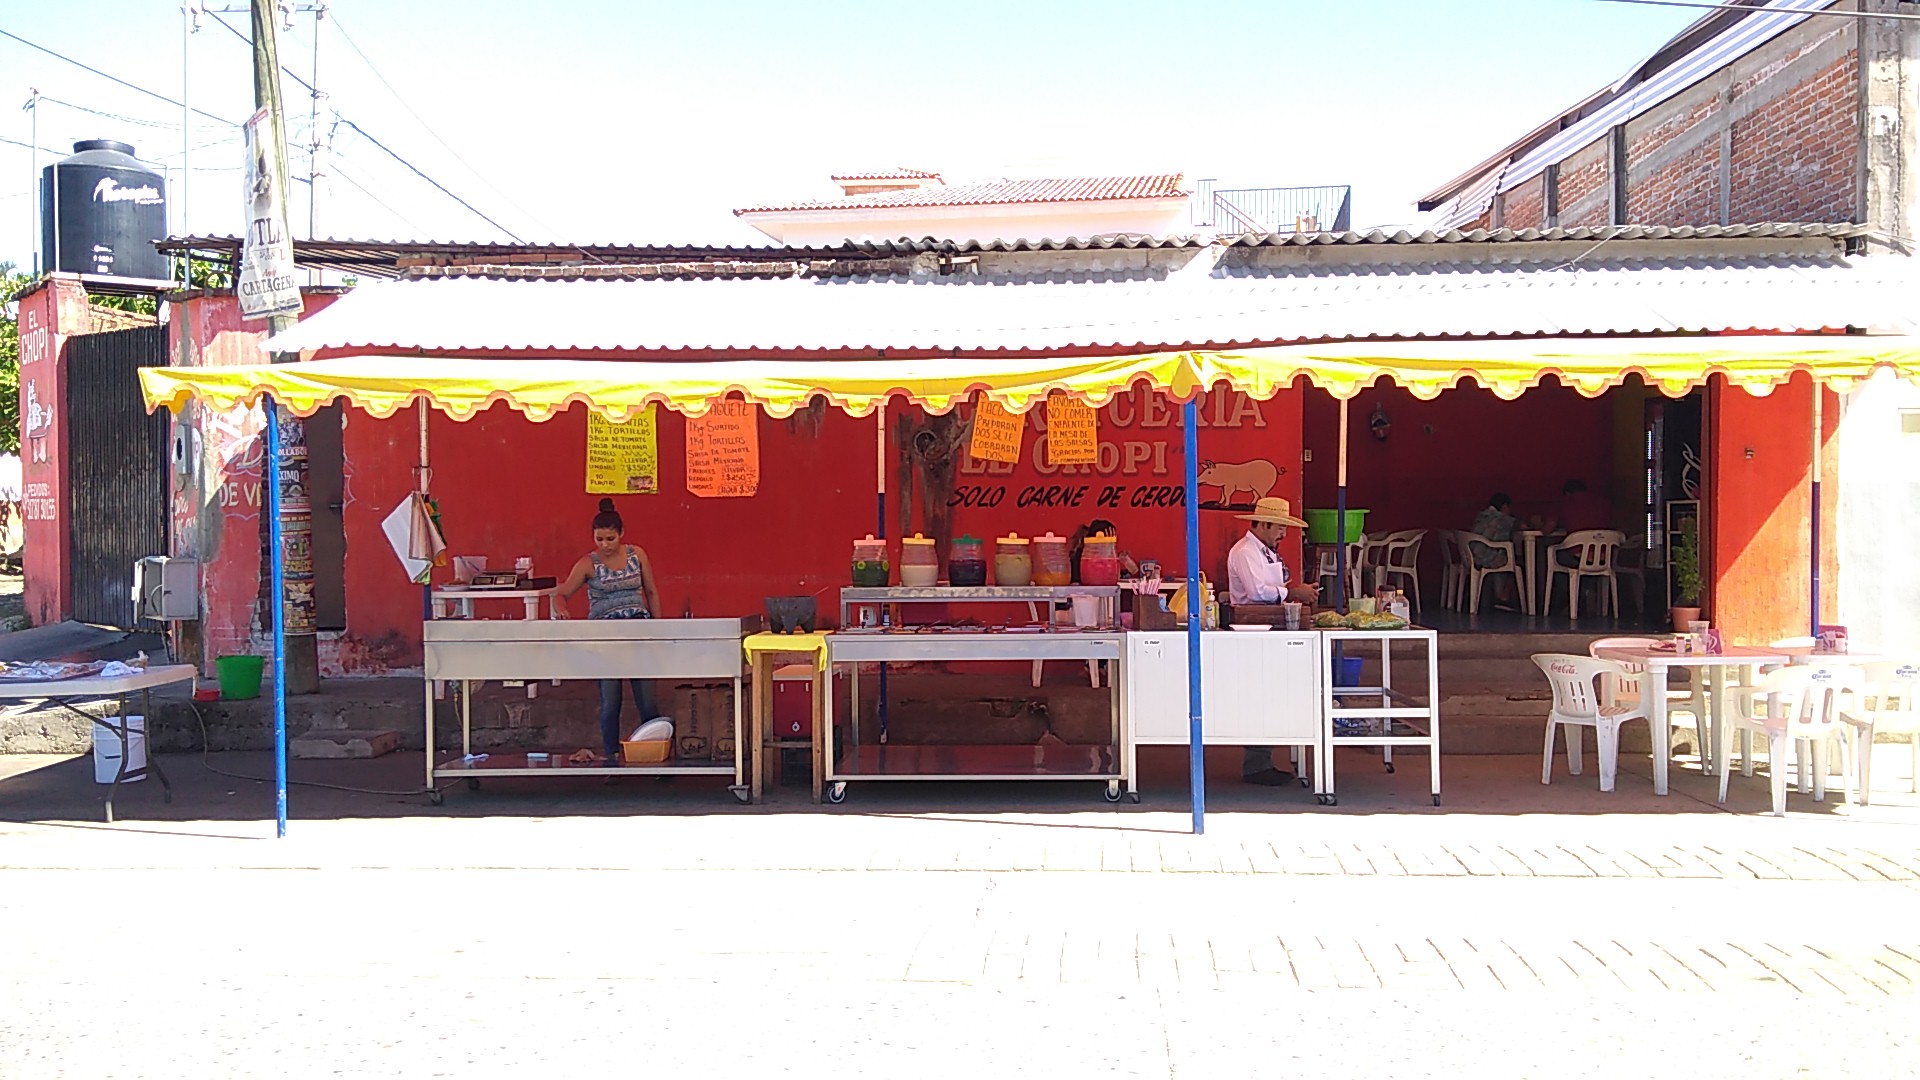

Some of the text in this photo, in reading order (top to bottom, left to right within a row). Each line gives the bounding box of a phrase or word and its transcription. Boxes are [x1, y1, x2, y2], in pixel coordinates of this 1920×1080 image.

[29, 309, 38, 329] EL
[21, 326, 48, 365] CHOPI
[709, 401, 749, 417] AQUETE
[1048, 407, 1093, 419] NO COMER
[608, 426, 651, 436] TORTILLAS
[1060, 430, 1078, 438] MESA
[1032, 433, 1168, 475] COPI
[947, 485, 1006, 508] SOLO
[1016, 485, 1090, 509] CARNE
[1097, 485, 1126, 507] DE
